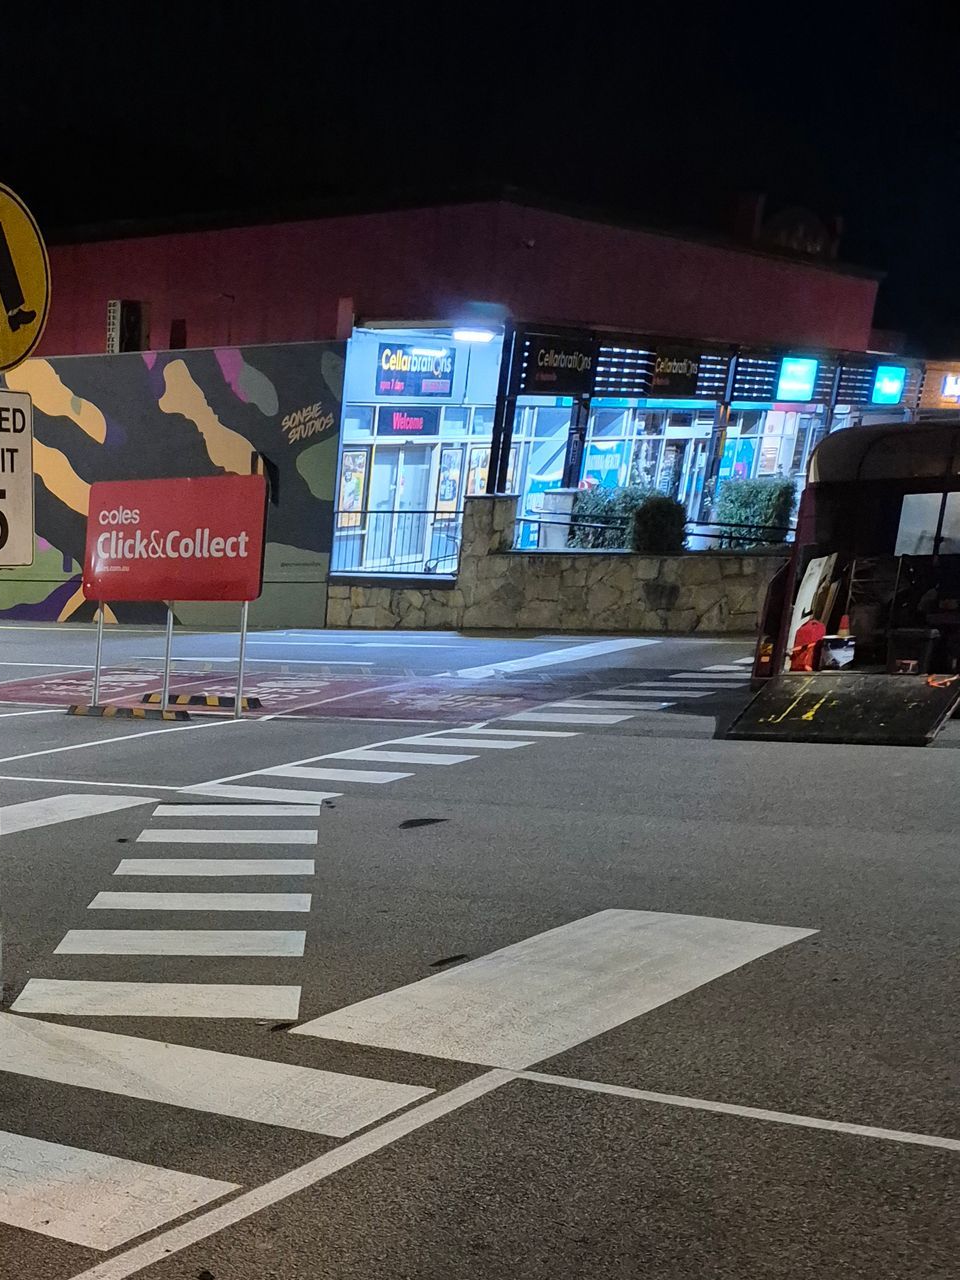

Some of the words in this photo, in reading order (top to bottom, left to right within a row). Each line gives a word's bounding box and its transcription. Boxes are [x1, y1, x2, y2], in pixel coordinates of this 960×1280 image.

[281, 401, 322, 432] SONSIE
[288, 412, 335, 445] STUDIOS
[392, 411, 424, 430] Welcome
[98, 505, 140, 525] coles
[96, 527, 249, 560] Click&Collect
